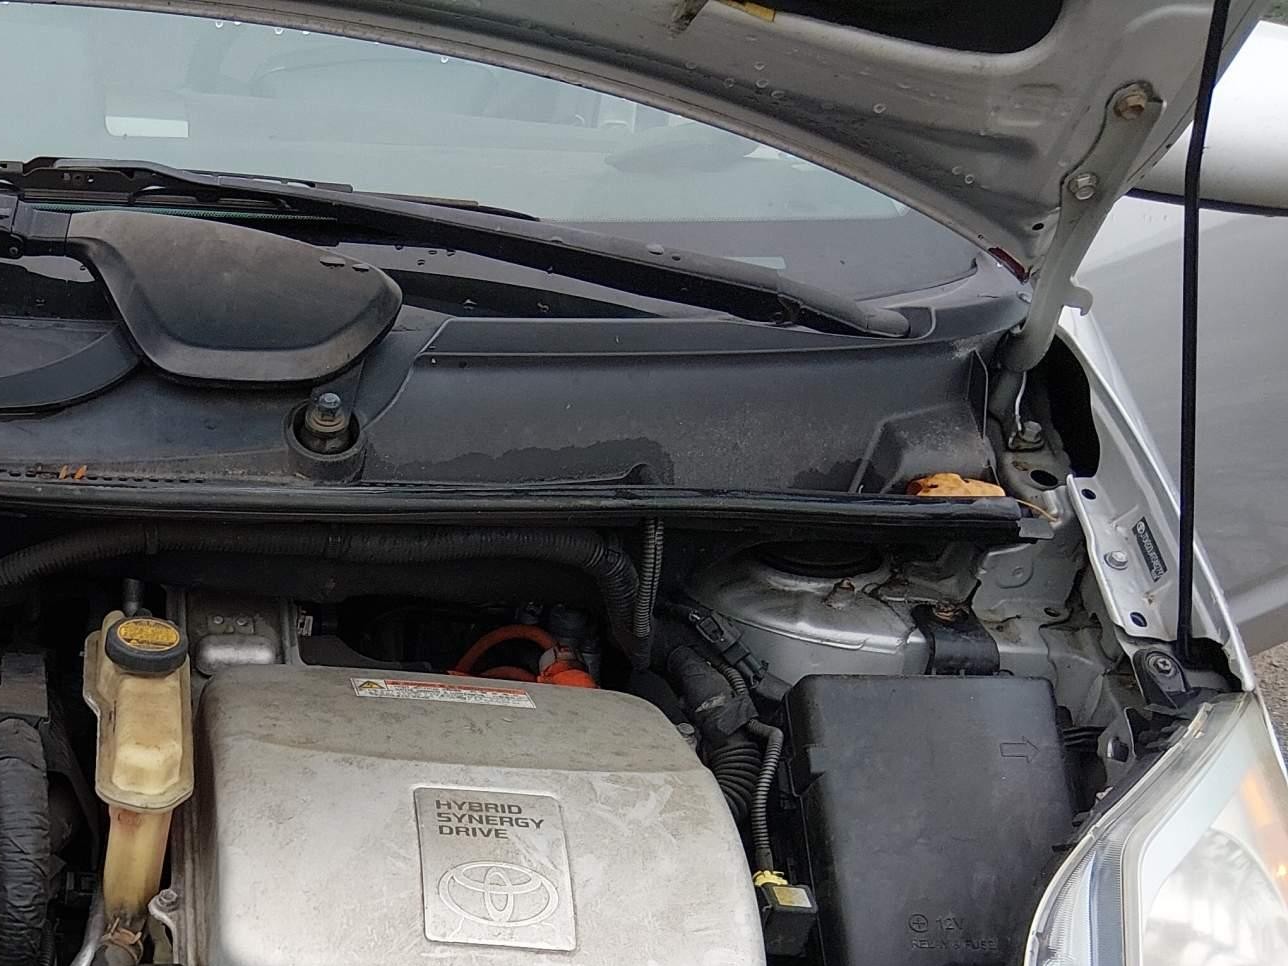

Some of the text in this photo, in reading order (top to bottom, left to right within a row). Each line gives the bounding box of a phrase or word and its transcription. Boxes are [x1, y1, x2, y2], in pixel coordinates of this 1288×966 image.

[435, 800, 522, 815] HYBRID
[437, 812, 544, 829] SYNERGY
[438, 825, 509, 840] DRIVE
